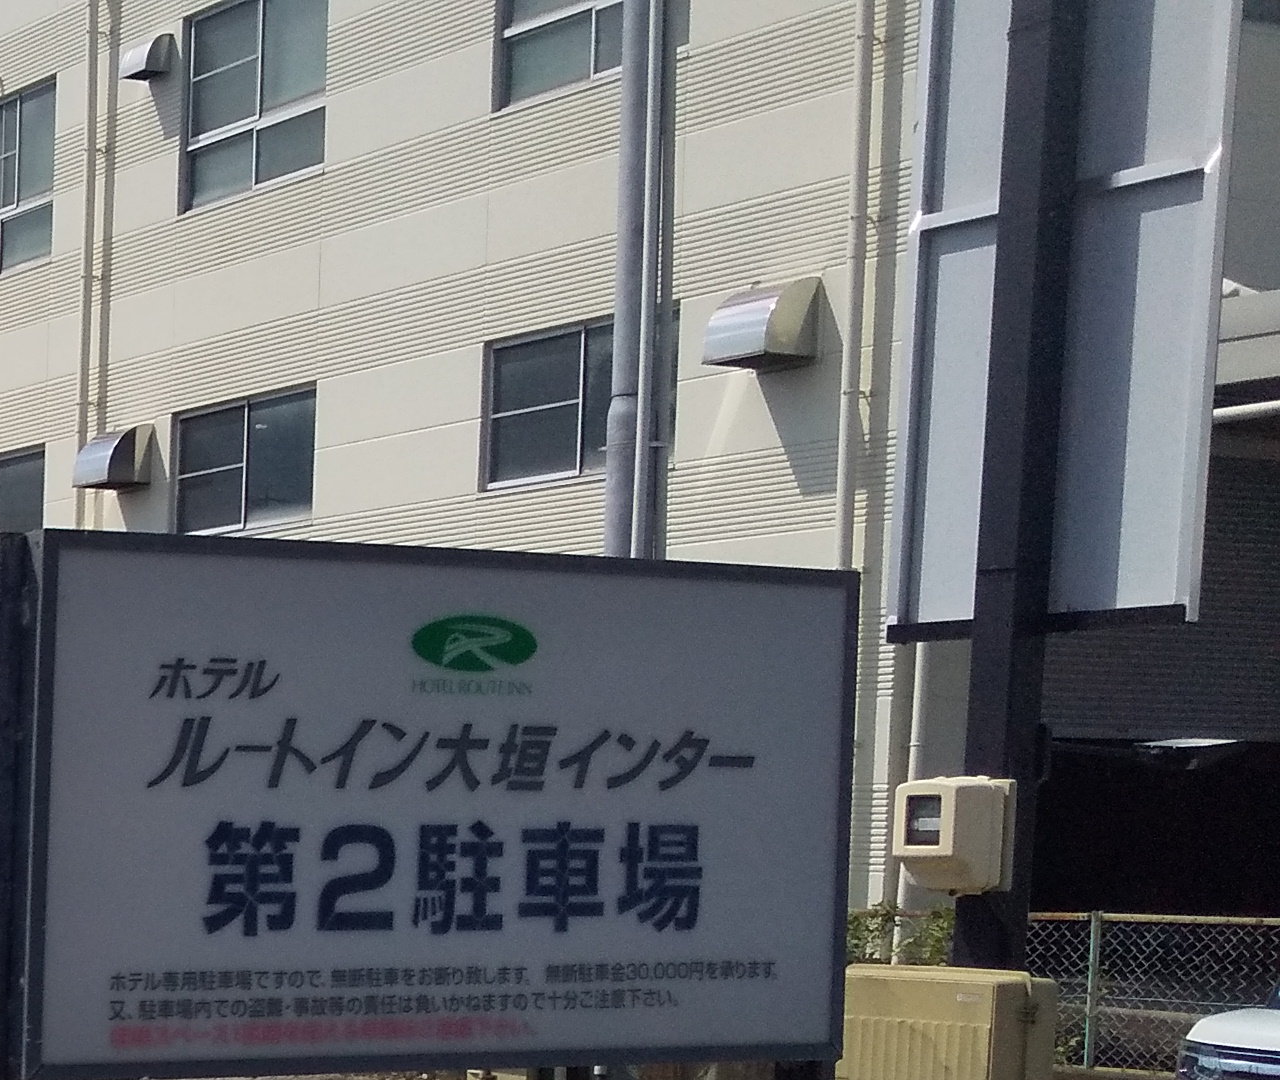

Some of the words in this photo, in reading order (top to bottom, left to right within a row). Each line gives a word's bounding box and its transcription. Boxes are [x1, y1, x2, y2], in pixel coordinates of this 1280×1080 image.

[149, 658, 280, 699] ホテル
[147, 716, 755, 791] ルートイン大垣インター
[202, 821, 703, 936] 第2駐車場
